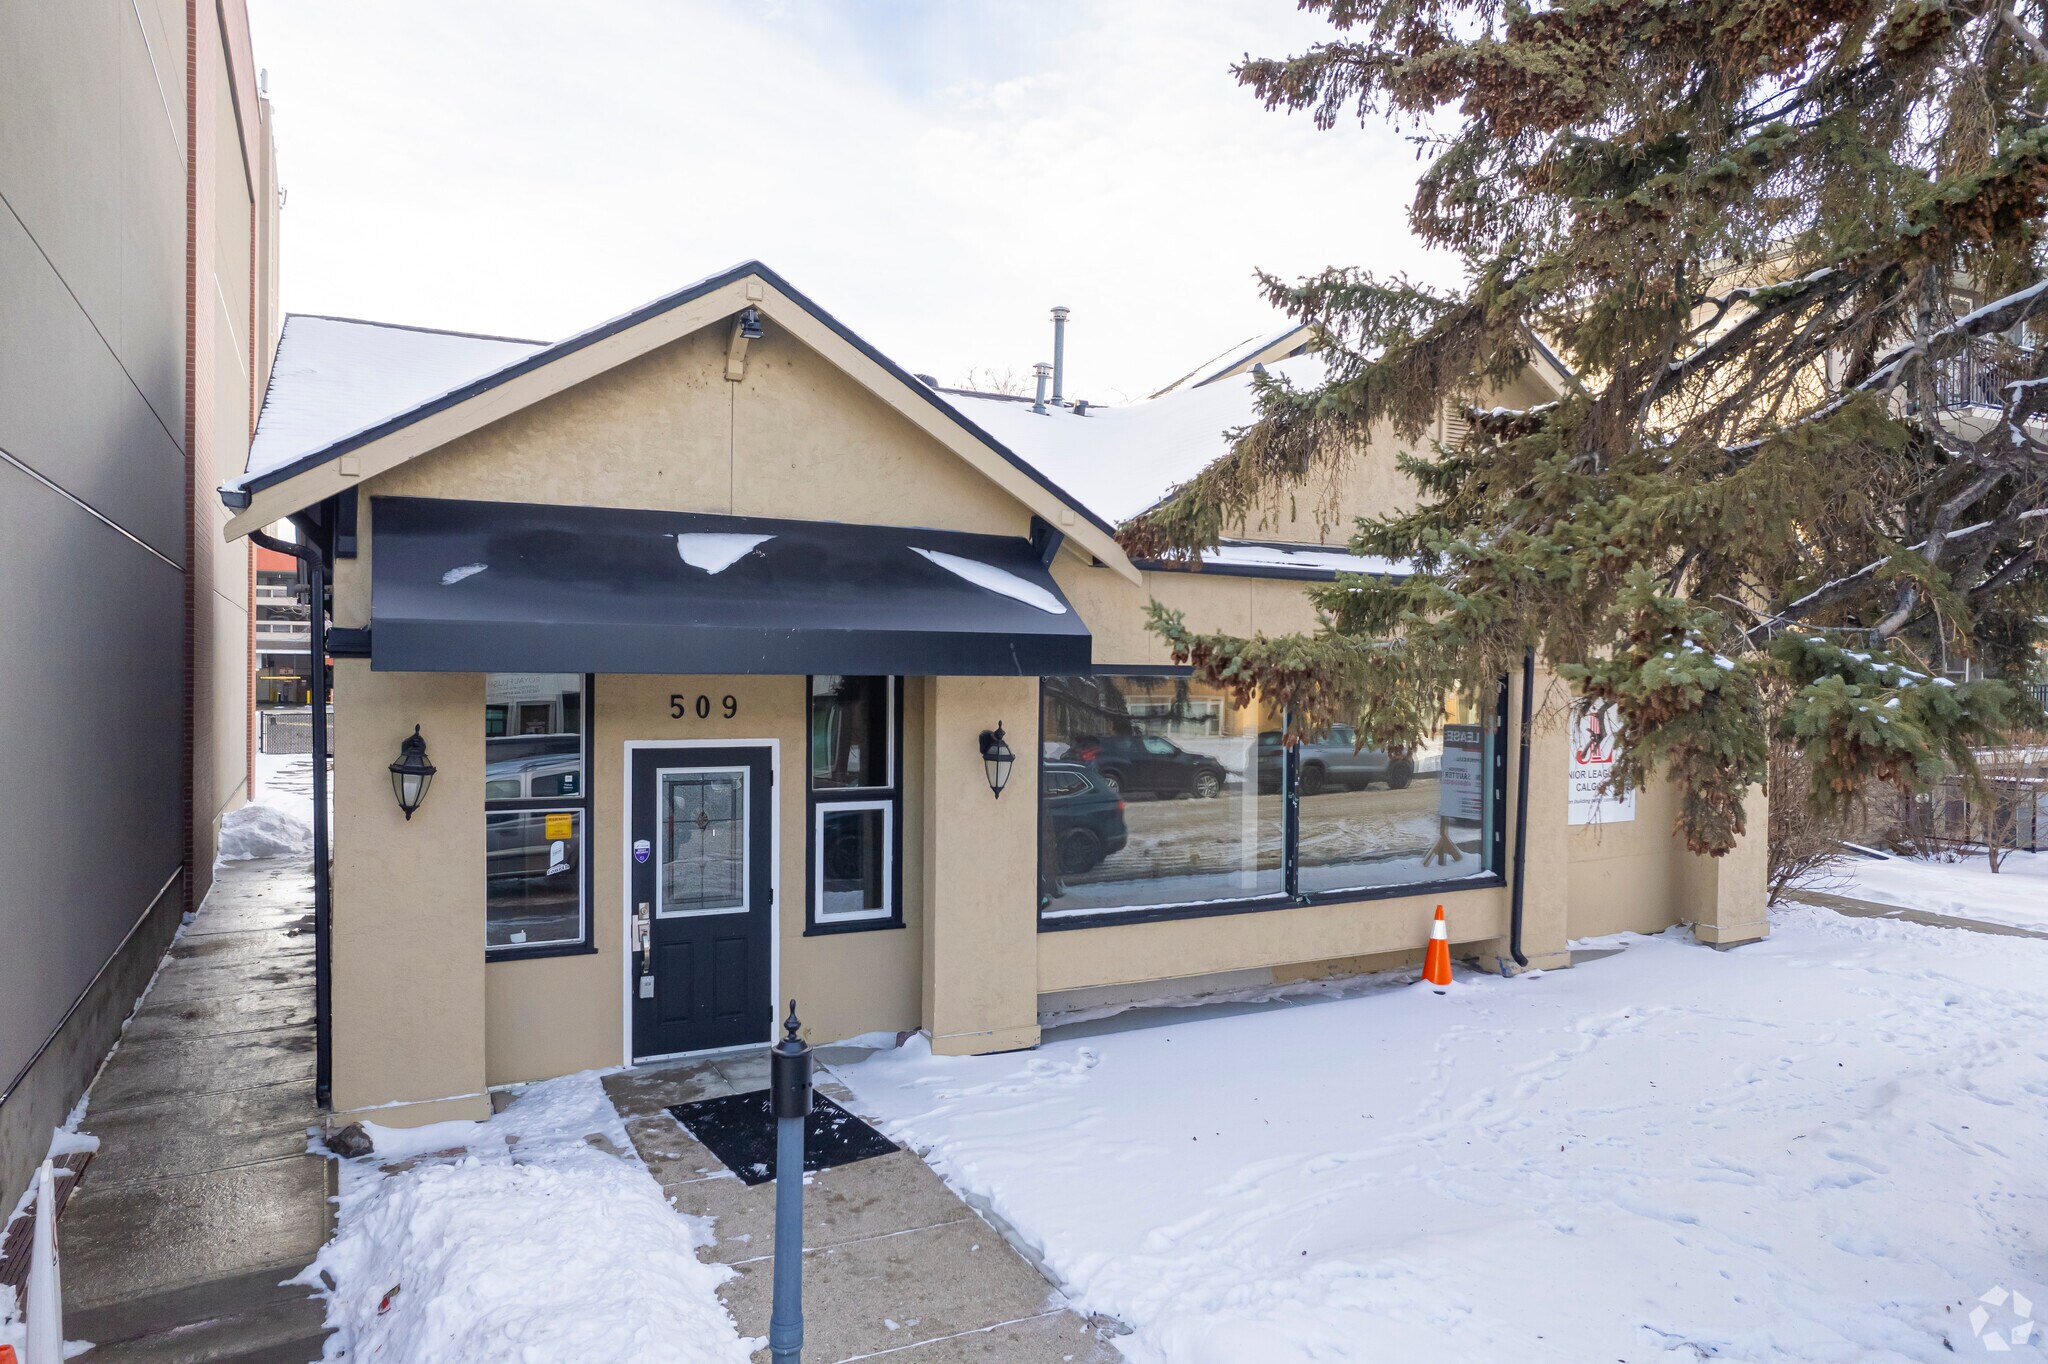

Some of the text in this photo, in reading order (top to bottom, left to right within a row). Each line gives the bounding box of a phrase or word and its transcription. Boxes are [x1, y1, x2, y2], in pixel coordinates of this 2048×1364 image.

[670, 694, 737, 719] 509
[1568, 769, 1610, 779] NIOR LEAG
